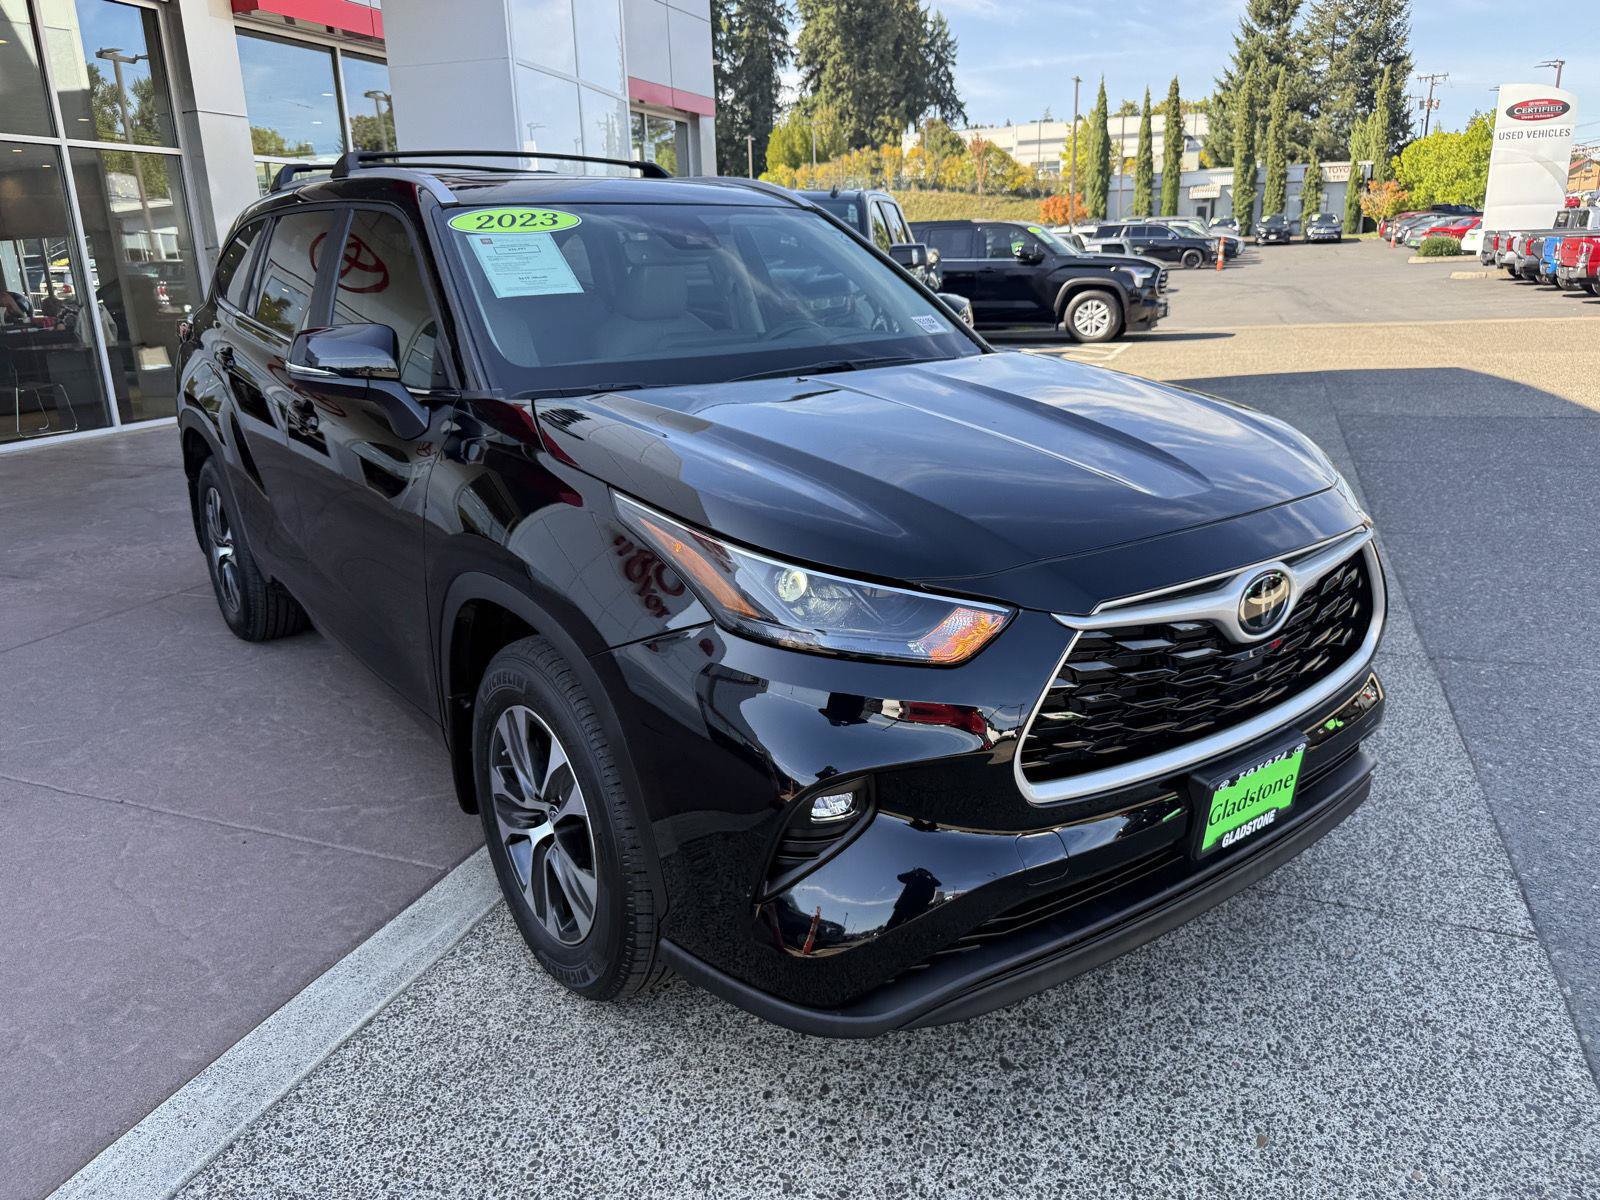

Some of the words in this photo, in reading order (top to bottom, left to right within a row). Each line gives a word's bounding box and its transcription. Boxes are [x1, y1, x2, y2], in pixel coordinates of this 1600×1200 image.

[1514, 105, 1563, 115] CERTIFIED
[1499, 131, 1524, 141] USED
[1526, 128, 1571, 139] VEHICLES
[475, 212, 559, 230] 2023
[1238, 751, 1288, 780] TOYOTA
[1208, 773, 1294, 827] Gladstone
[1221, 809, 1277, 849] GLADSTONE
